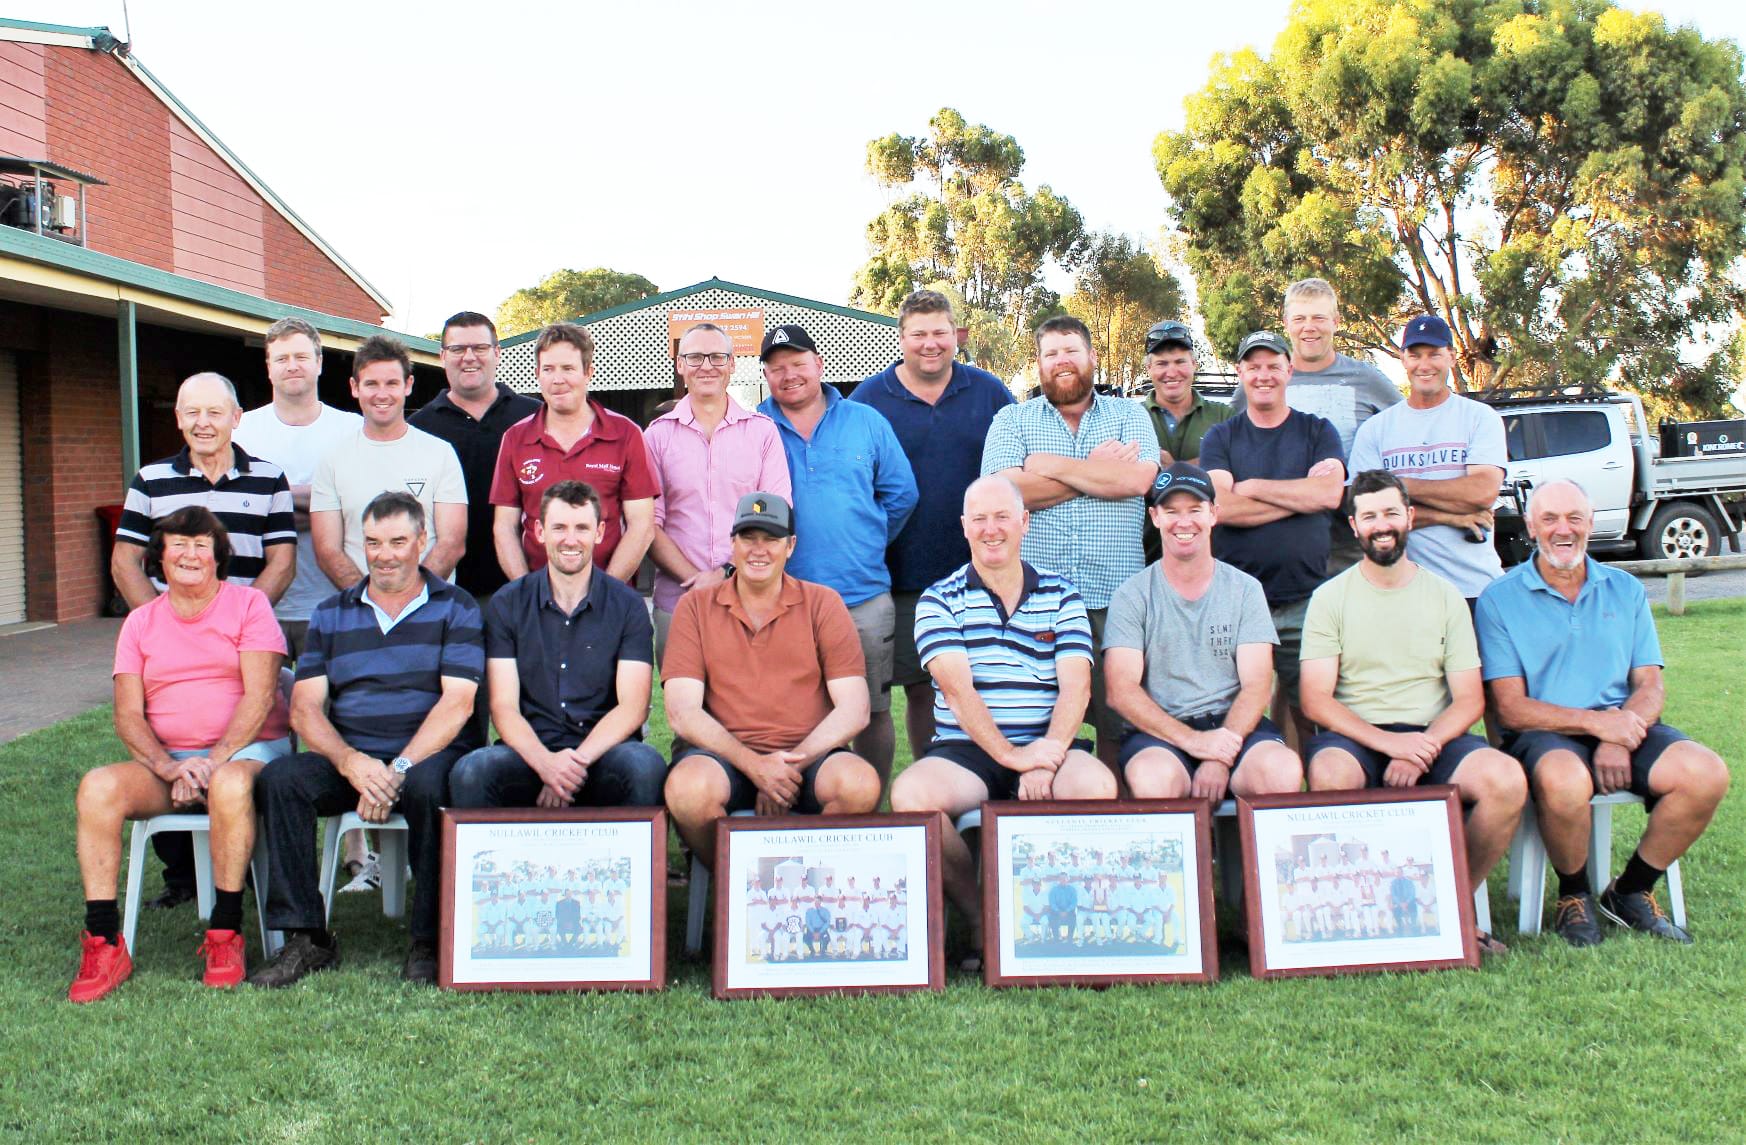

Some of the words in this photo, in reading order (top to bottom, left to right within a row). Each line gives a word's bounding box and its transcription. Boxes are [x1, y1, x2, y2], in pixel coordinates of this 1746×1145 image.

[693, 312, 720, 321] Shop
[719, 311, 746, 320] Swan
[1383, 449, 1468, 471] QUIKSILVER
[1342, 808, 1385, 819] CRICKET
[1387, 807, 1416, 817] CLUB
[544, 828, 588, 837] CRICKET
[591, 827, 619, 837] CLUB
[763, 834, 814, 844] NULLAWIL
[818, 833, 862, 843] CRICKET
[865, 832, 893, 842] CLUB
